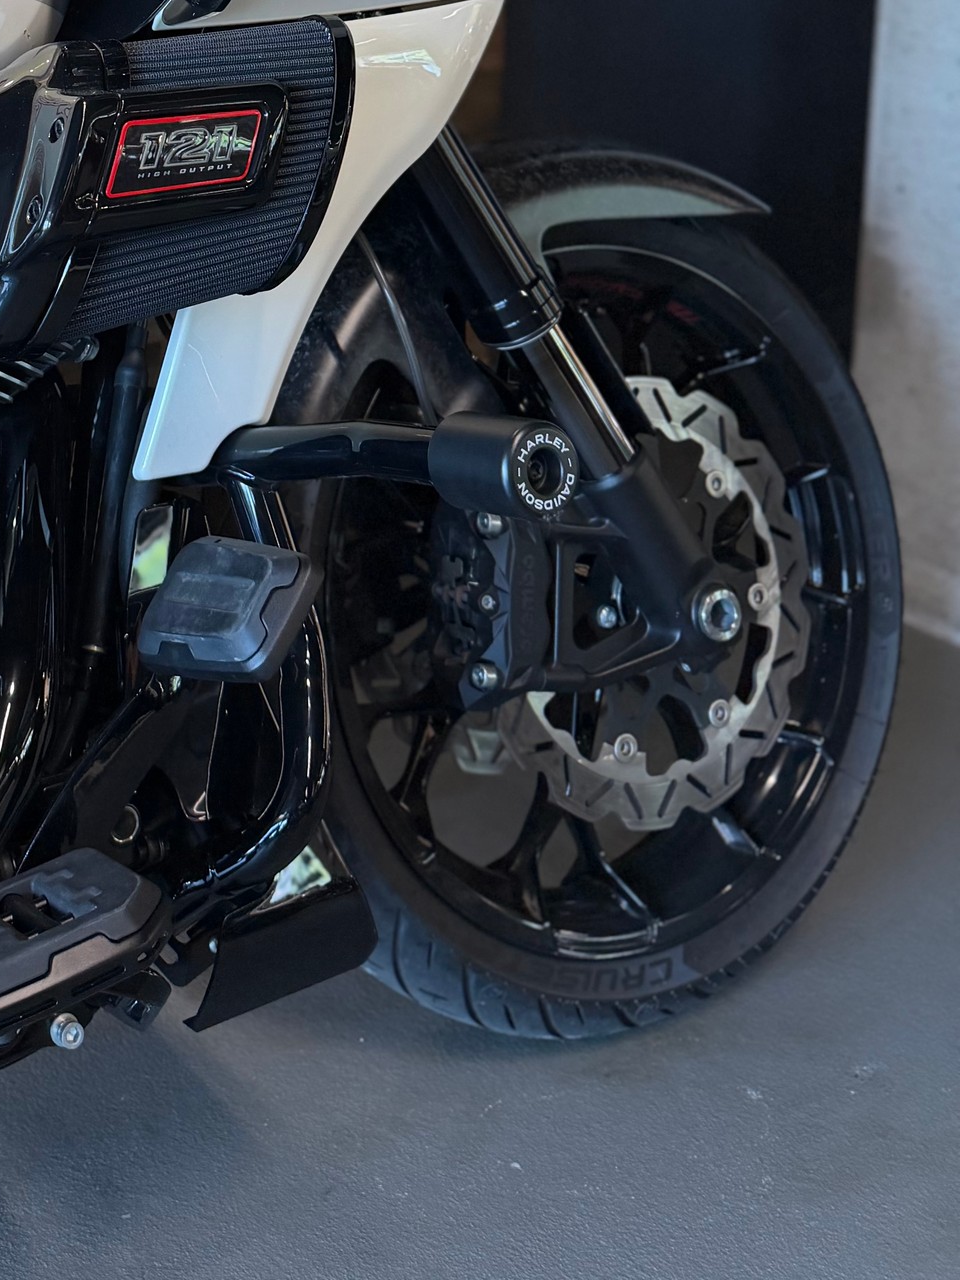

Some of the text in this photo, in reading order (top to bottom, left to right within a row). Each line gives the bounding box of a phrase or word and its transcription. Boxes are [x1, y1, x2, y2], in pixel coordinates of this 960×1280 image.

[139, 122, 238, 170] 121
[137, 163, 234, 180] HIGH OUTPUT
